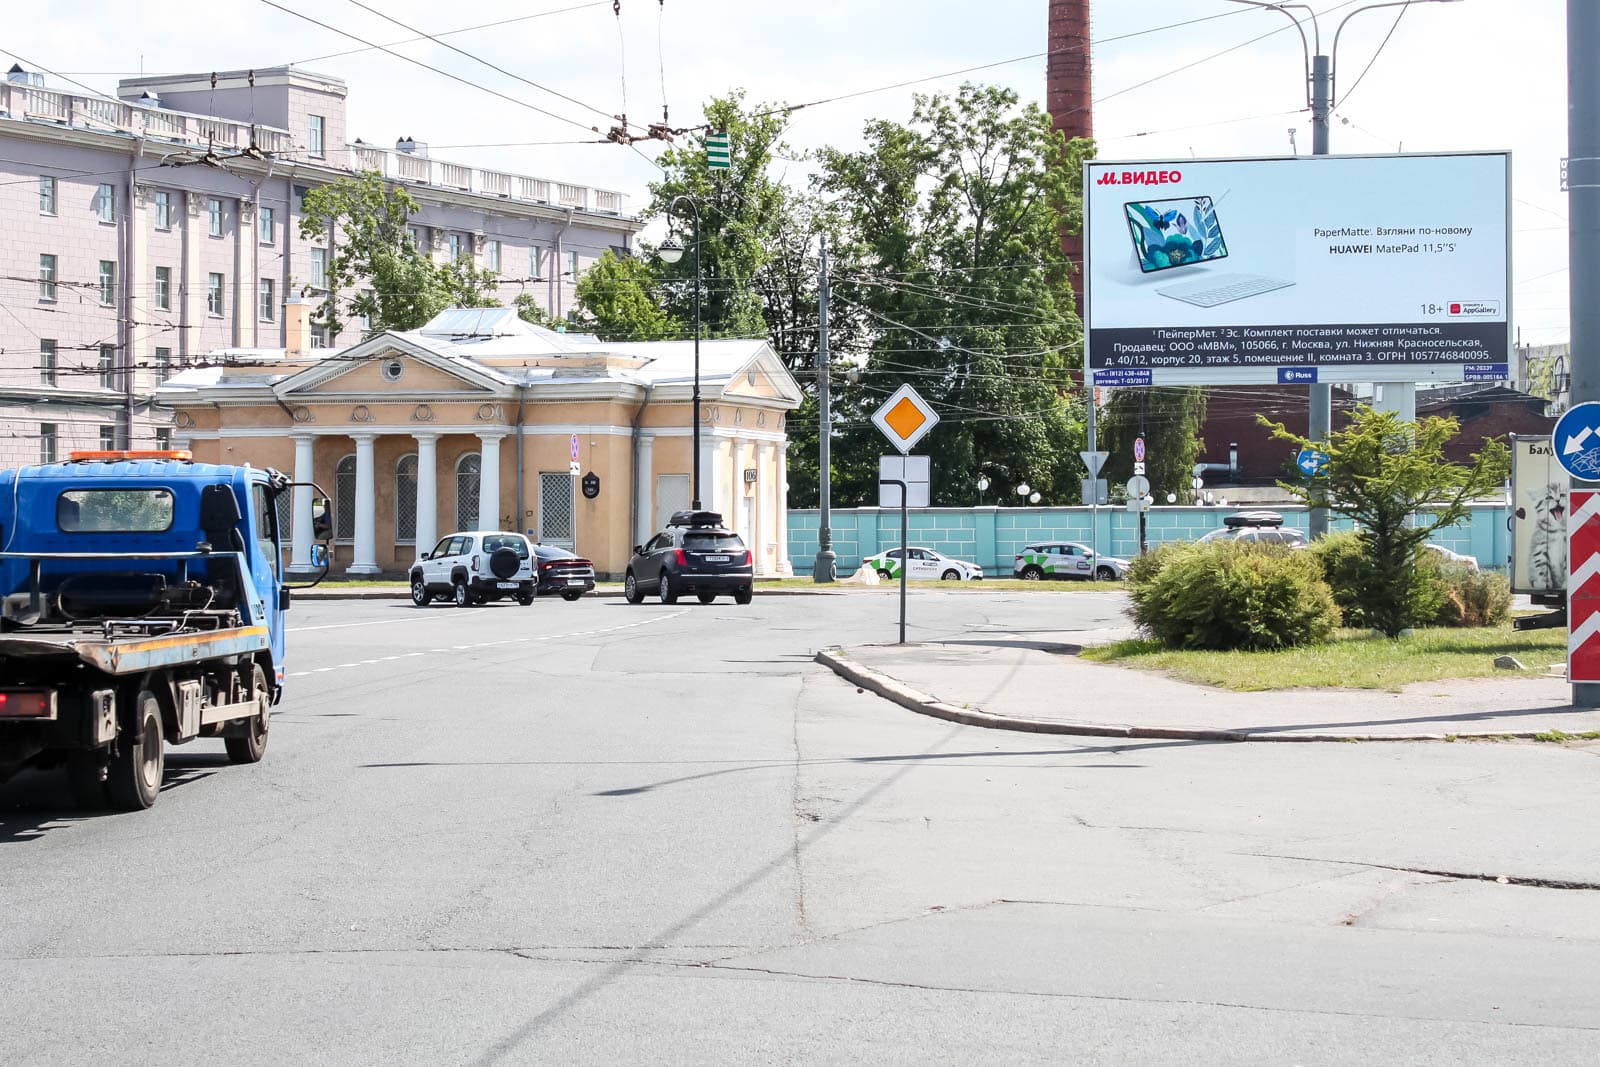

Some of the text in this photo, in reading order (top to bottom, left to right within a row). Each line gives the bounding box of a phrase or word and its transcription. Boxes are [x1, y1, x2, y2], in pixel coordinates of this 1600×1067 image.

[1376, 228, 1415, 236] Взгляни
[1419, 227, 1472, 236] по-новому
[1329, 246, 1372, 254] HUAWEI
[1376, 245, 1419, 253] MatePad
[1421, 304, 1443, 314] 18+
[1158, 330, 1218, 339] ПейперМет.
[1243, 326, 1293, 338] Комплект
[1297, 328, 1343, 336] поставки
[1383, 327, 1442, 335] отличаться.
[1114, 343, 1166, 353] Продавец:
[1170, 343, 1194, 351] ООО
[1241, 341, 1279, 350] 105066,
[1292, 340, 1333, 349] Москва,
[1336, 341, 1350, 350] ул.
[1354, 340, 1394, 348] Нижняя
[1398, 339, 1483, 349] Красносельская,
[1105, 357, 1114, 366] д.
[1118, 355, 1148, 365] 40/12,
[1152, 356, 1185, 365] корпус
[1189, 355, 1203, 364] 20,
[1207, 355, 1229, 363] этаж
[1233, 354, 1242, 363] 5,
[1245, 353, 1303, 364] помещение
[1320, 353, 1363, 361] комната
[1366, 353, 1374, 361] 3.
[1378, 352, 1405, 361] ОГРН
[1410, 350, 1492, 361] 1057746840095.
